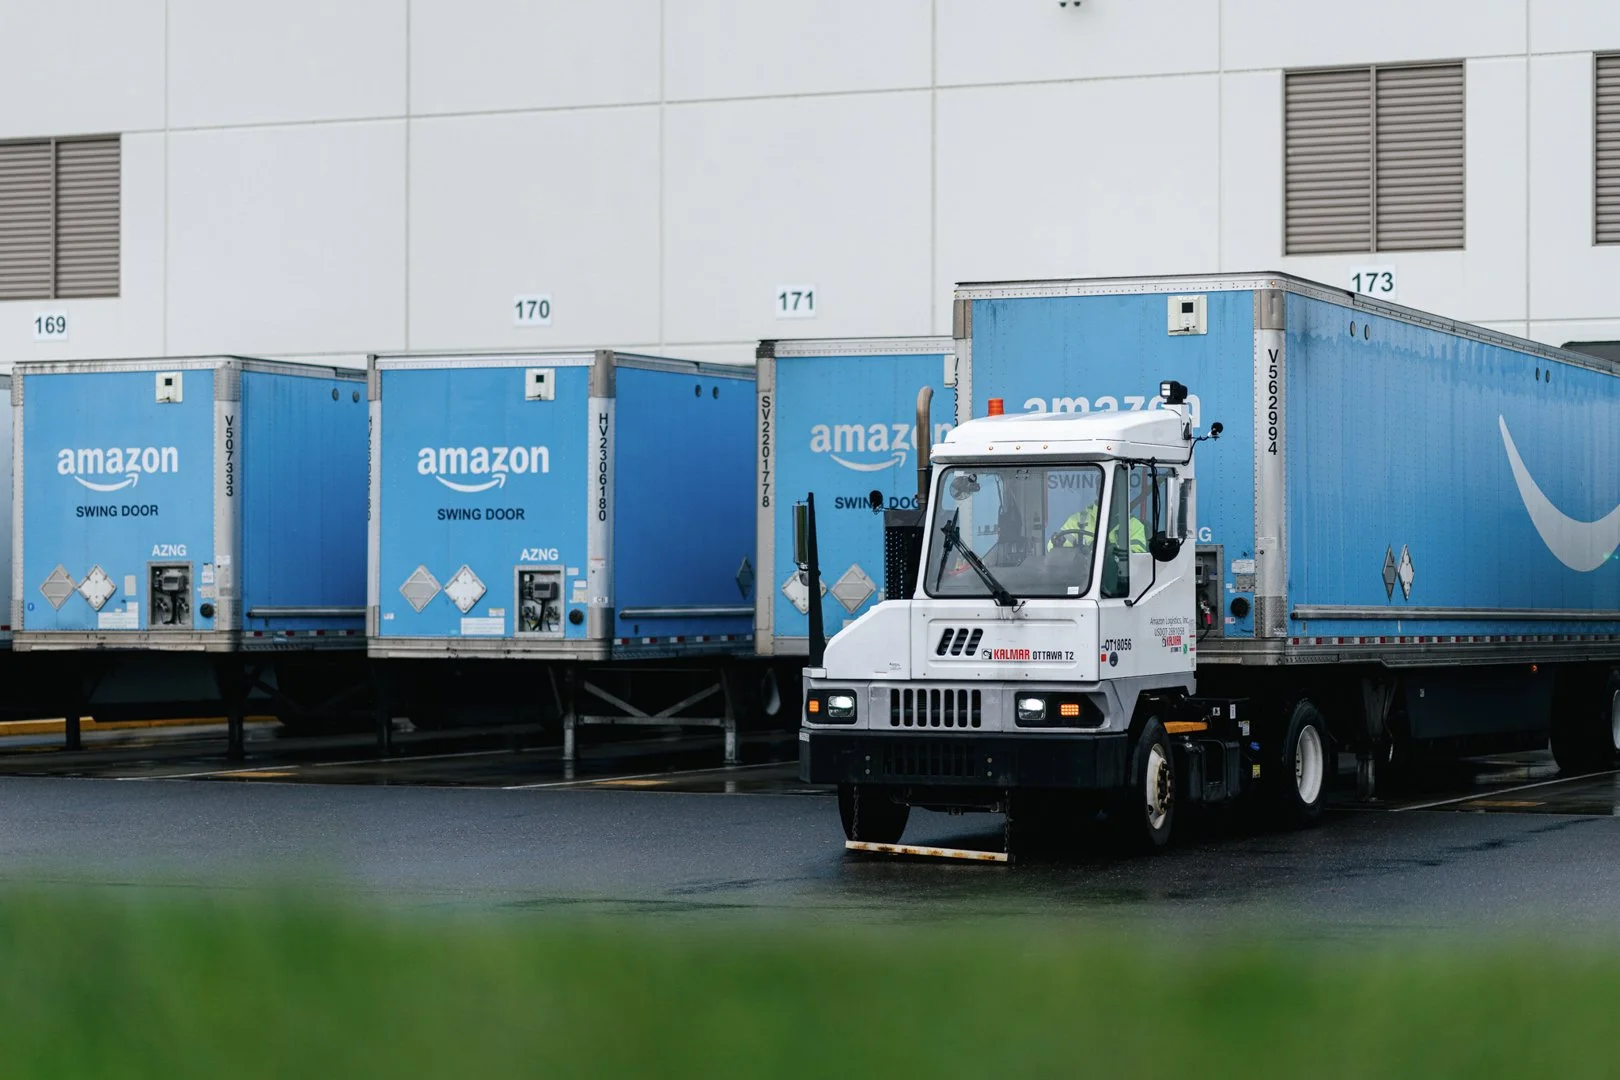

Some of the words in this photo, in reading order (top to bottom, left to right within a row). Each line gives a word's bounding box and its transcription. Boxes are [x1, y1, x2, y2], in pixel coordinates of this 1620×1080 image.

[1352, 272, 1394, 293] 173
[514, 299, 550, 319] 170
[778, 291, 814, 311] 171
[34, 316, 66, 335] 169
[1267, 348, 1279, 456] V562994
[57, 446, 179, 475] amazon
[225, 415, 234, 497] V507333
[417, 445, 550, 475] amazon
[761, 395, 771, 508] SV2201778
[599, 412, 609, 522] HV2306180
[1047, 473, 1100, 490] SWIN
[76, 506, 118, 518] SWING
[121, 504, 159, 517] DOOR
[834, 496, 883, 509] SWIN
[889, 496, 919, 510] DOO
[437, 508, 482, 521] SWING
[485, 508, 525, 521] DOOR
[152, 544, 187, 557] AZNG
[520, 548, 559, 561] AZNG
[993, 649, 1030, 660] KALMAR
[1032, 651, 1062, 660] OTTAWA
[1065, 651, 1074, 660] T2
[1105, 638, 1132, 652] OT18056
